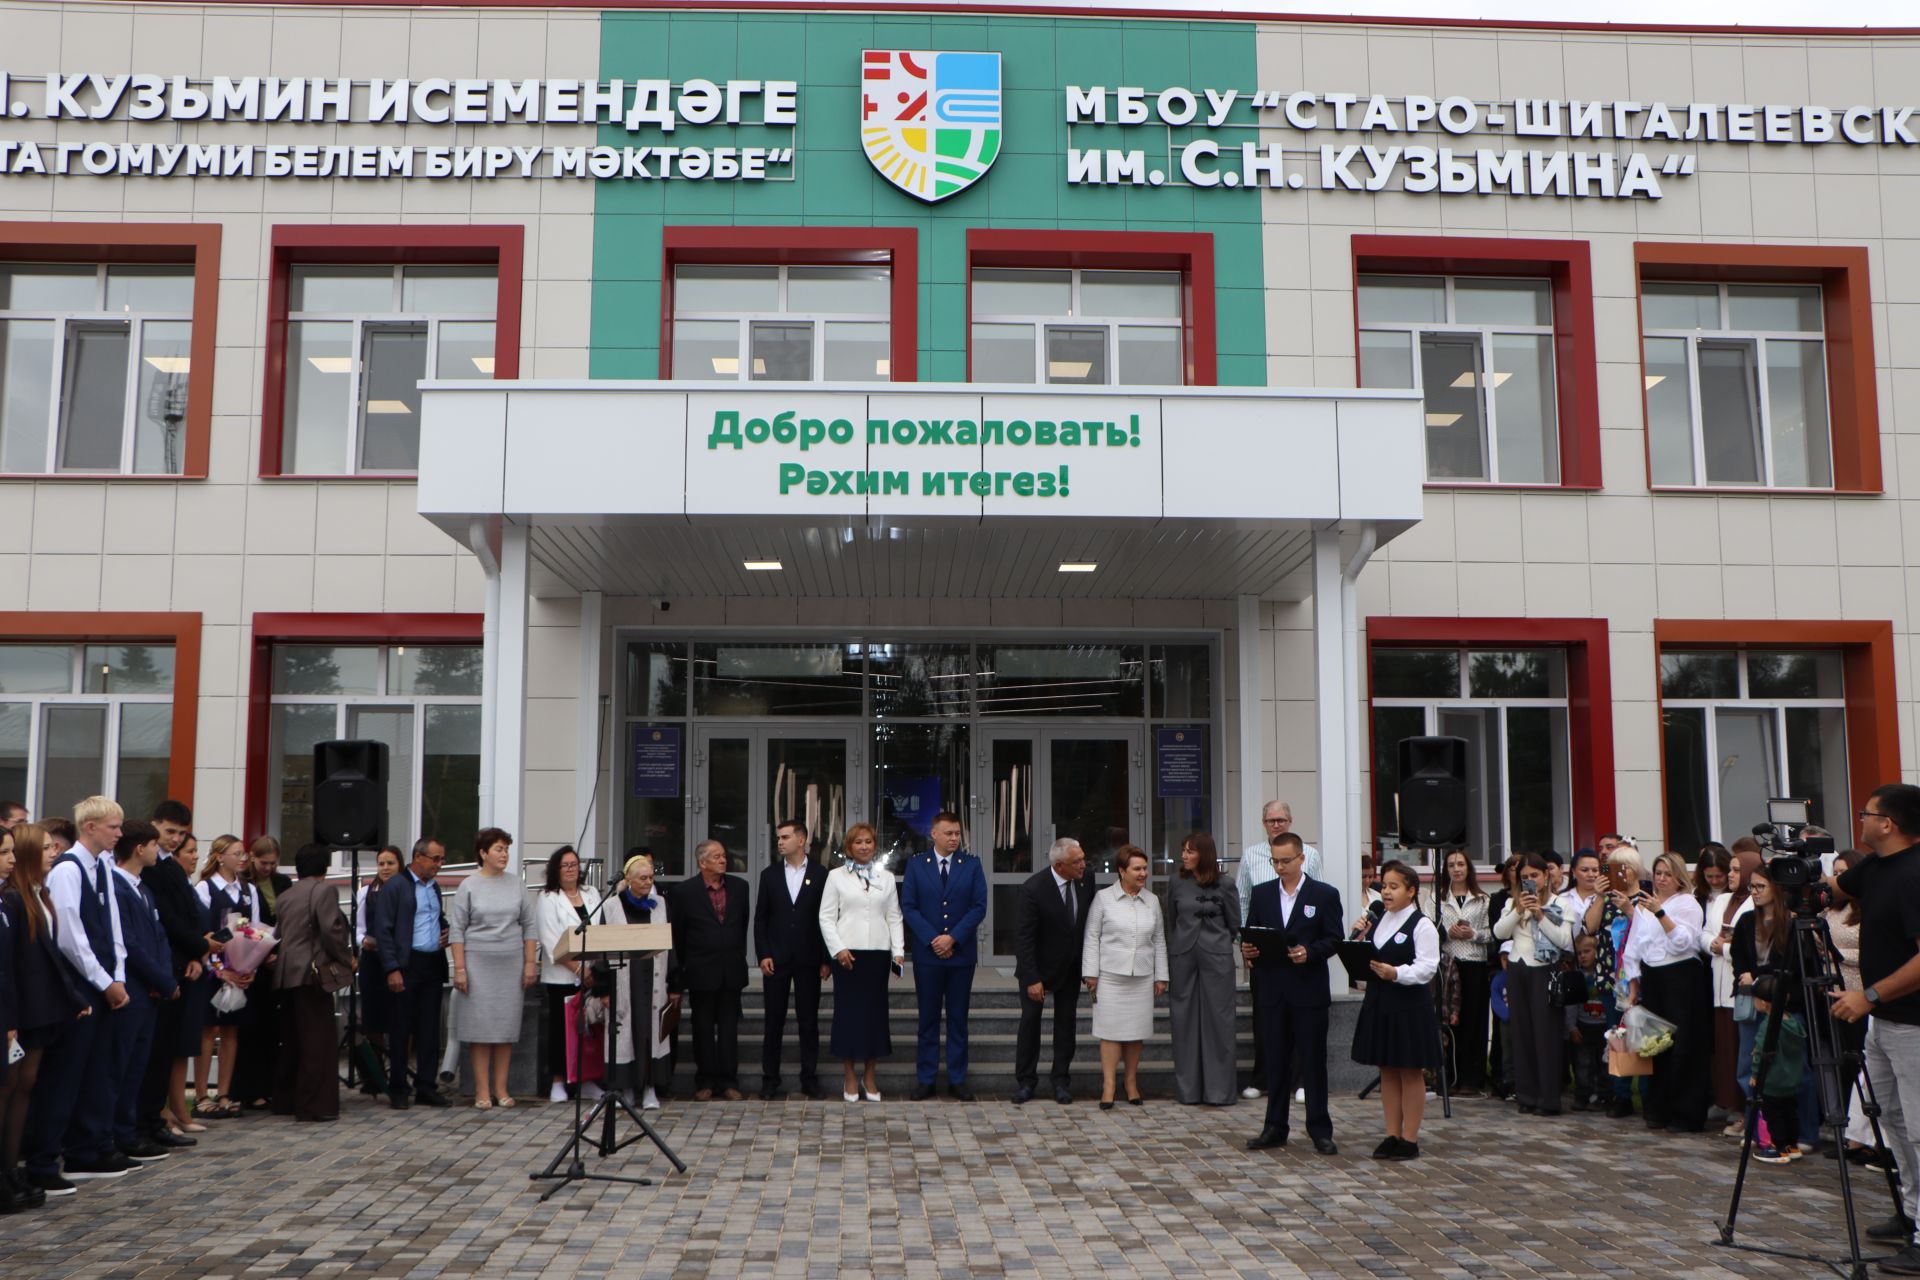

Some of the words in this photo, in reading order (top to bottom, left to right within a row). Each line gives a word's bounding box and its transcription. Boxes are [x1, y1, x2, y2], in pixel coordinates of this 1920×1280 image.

[46, 73, 351, 121] КУЗЬМИН
[368, 78, 797, 133] ИСЕМЕНДӘГЕ
[1066, 86, 1238, 127] МБОУ
[57, 142, 254, 176] ГОМУМИ
[265, 144, 414, 177] БЕЛЕМ
[1180, 139, 1304, 188] С.Н.
[707, 411, 854, 451] Добро
[866, 414, 1141, 447] пожаловать!
[779, 463, 909, 495] Рәхим
[922, 465, 1070, 497] итегез!
